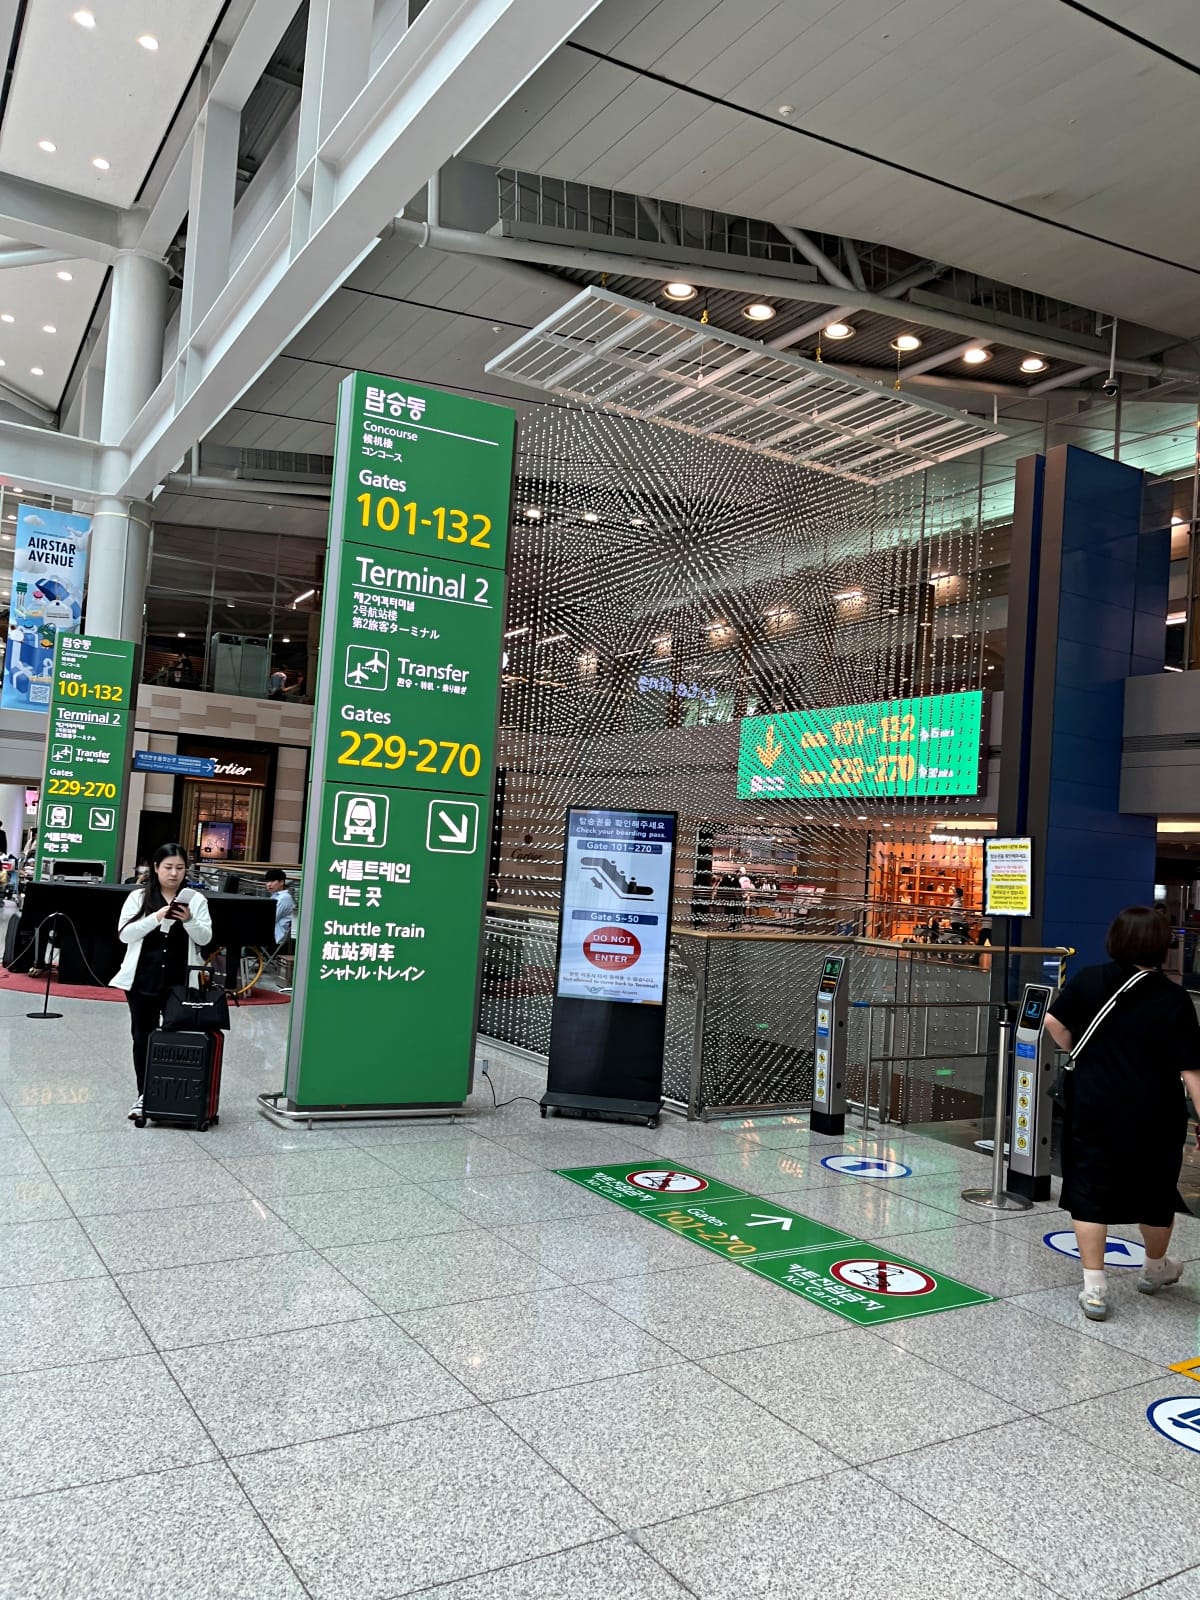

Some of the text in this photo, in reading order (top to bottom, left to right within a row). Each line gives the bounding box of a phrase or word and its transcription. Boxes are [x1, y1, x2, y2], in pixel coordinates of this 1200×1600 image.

[365, 386, 426, 421] 탑승동
[363, 420, 418, 441] Concourse
[361, 446, 403, 463] コンコース
[358, 469, 407, 492] Gates
[356, 492, 492, 549] 101-132
[27, 536, 76, 556] AIRSTAR
[28, 550, 74, 568] AVENUE
[355, 556, 489, 603] Terminal 2
[353, 591, 415, 613] 제2여객터미널
[352, 605, 398, 622] 2号航站楼
[352, 616, 441, 640] 第2旅客ターミナル
[62, 637, 92, 650] 탑승동
[59, 671, 83, 681] Gates
[397, 657, 470, 683] Transfer
[58, 680, 123, 702] 101-132
[56, 707, 121, 725] Terminal 2
[340, 704, 392, 725] Gates
[75, 748, 111, 760] Transfer
[337, 730, 481, 778] 229-270
[49, 768, 74, 777] Gates
[48, 778, 116, 799] 229-270
[616, 829, 647, 838] boarding
[586, 841, 609, 850] Gate
[329, 859, 411, 884] 셔틀트레인
[328, 884, 382, 907] 타는 곳
[590, 912, 640, 923] Gate 5~50
[323, 920, 425, 938] Shuttle Train
[593, 934, 632, 944] DO NOT
[322, 941, 396, 962] 航站列车
[594, 954, 628, 963] ENTER
[151, 1076, 203, 1100] STYLE
[686, 1207, 728, 1227] Gates
[657, 1210, 757, 1255] 101-270
[781, 1275, 845, 1307] No Carts
[788, 1263, 885, 1311] 카트진입금지
